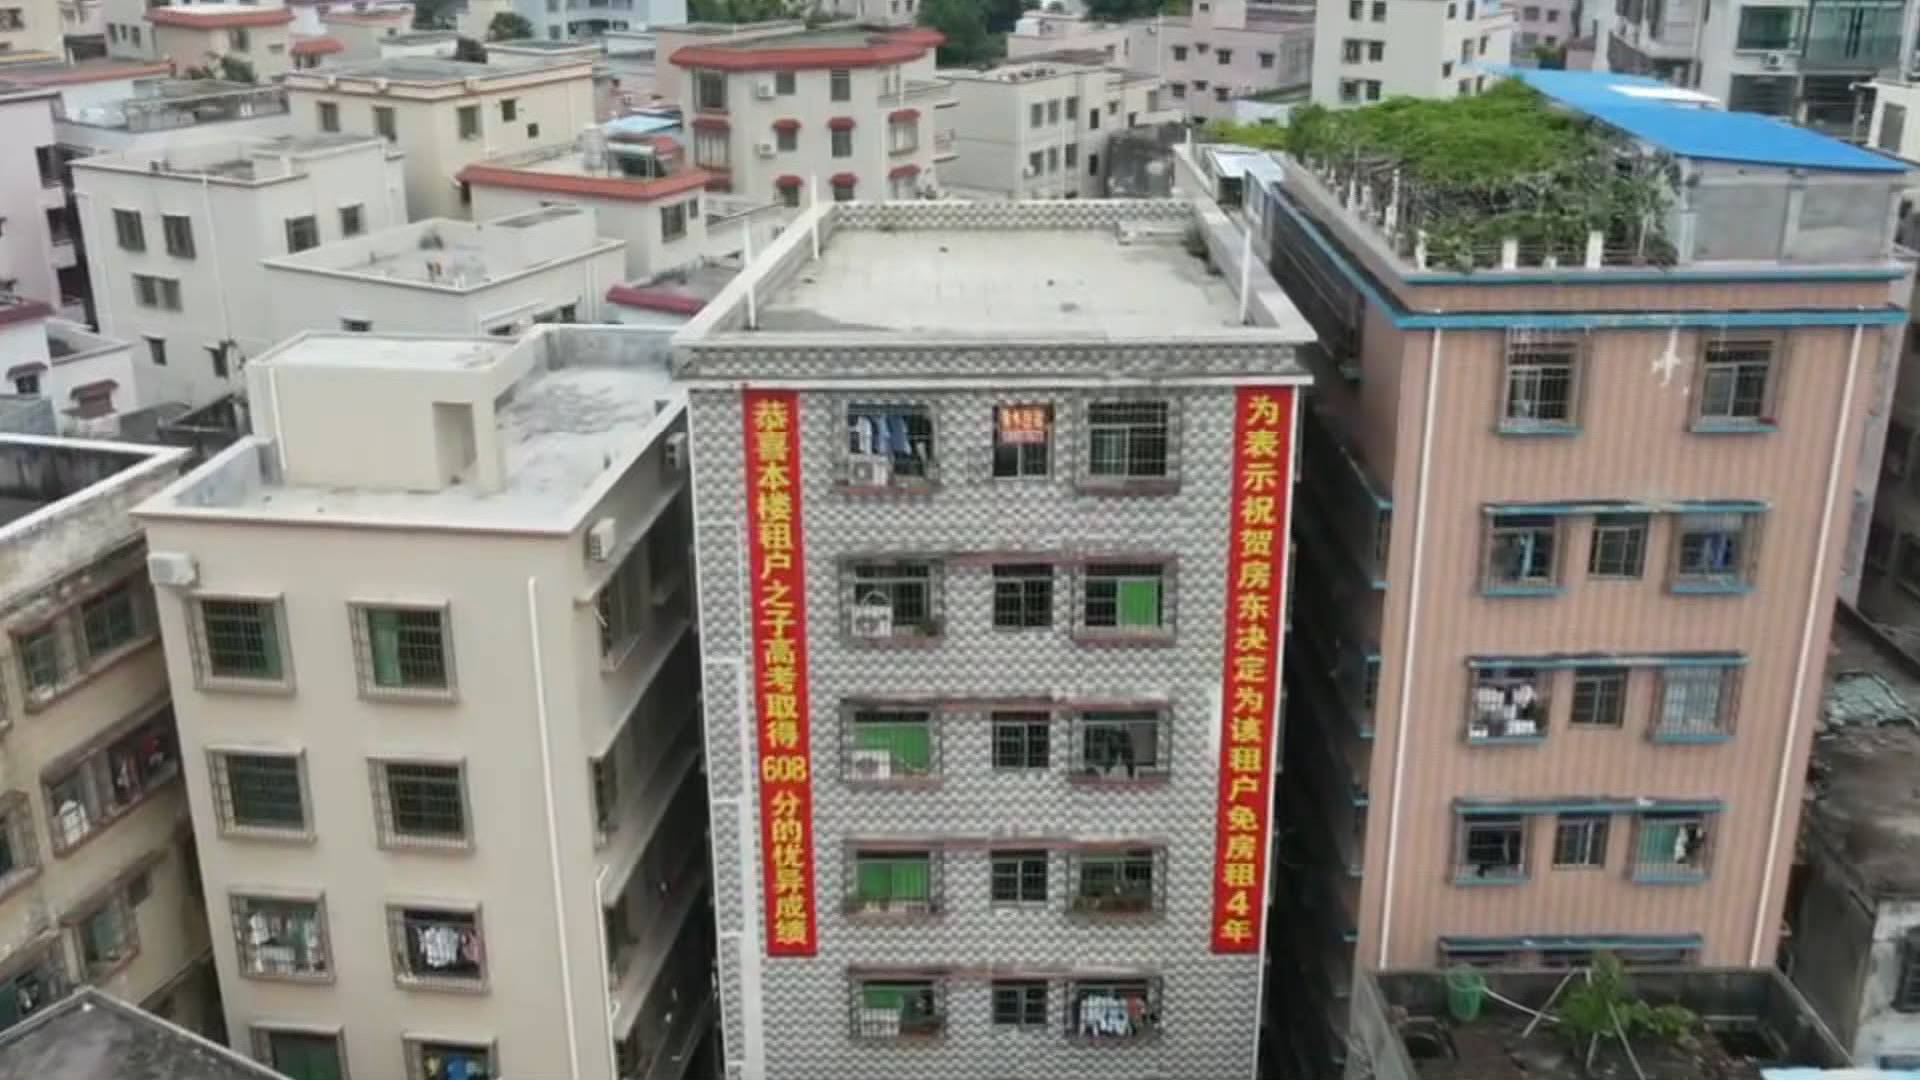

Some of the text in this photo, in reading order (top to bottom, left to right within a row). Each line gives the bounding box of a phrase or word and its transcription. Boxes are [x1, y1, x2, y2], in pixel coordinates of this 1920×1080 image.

[1219, 395, 1281, 943] 为表示祝贺房东决定为该租户免房租4年
